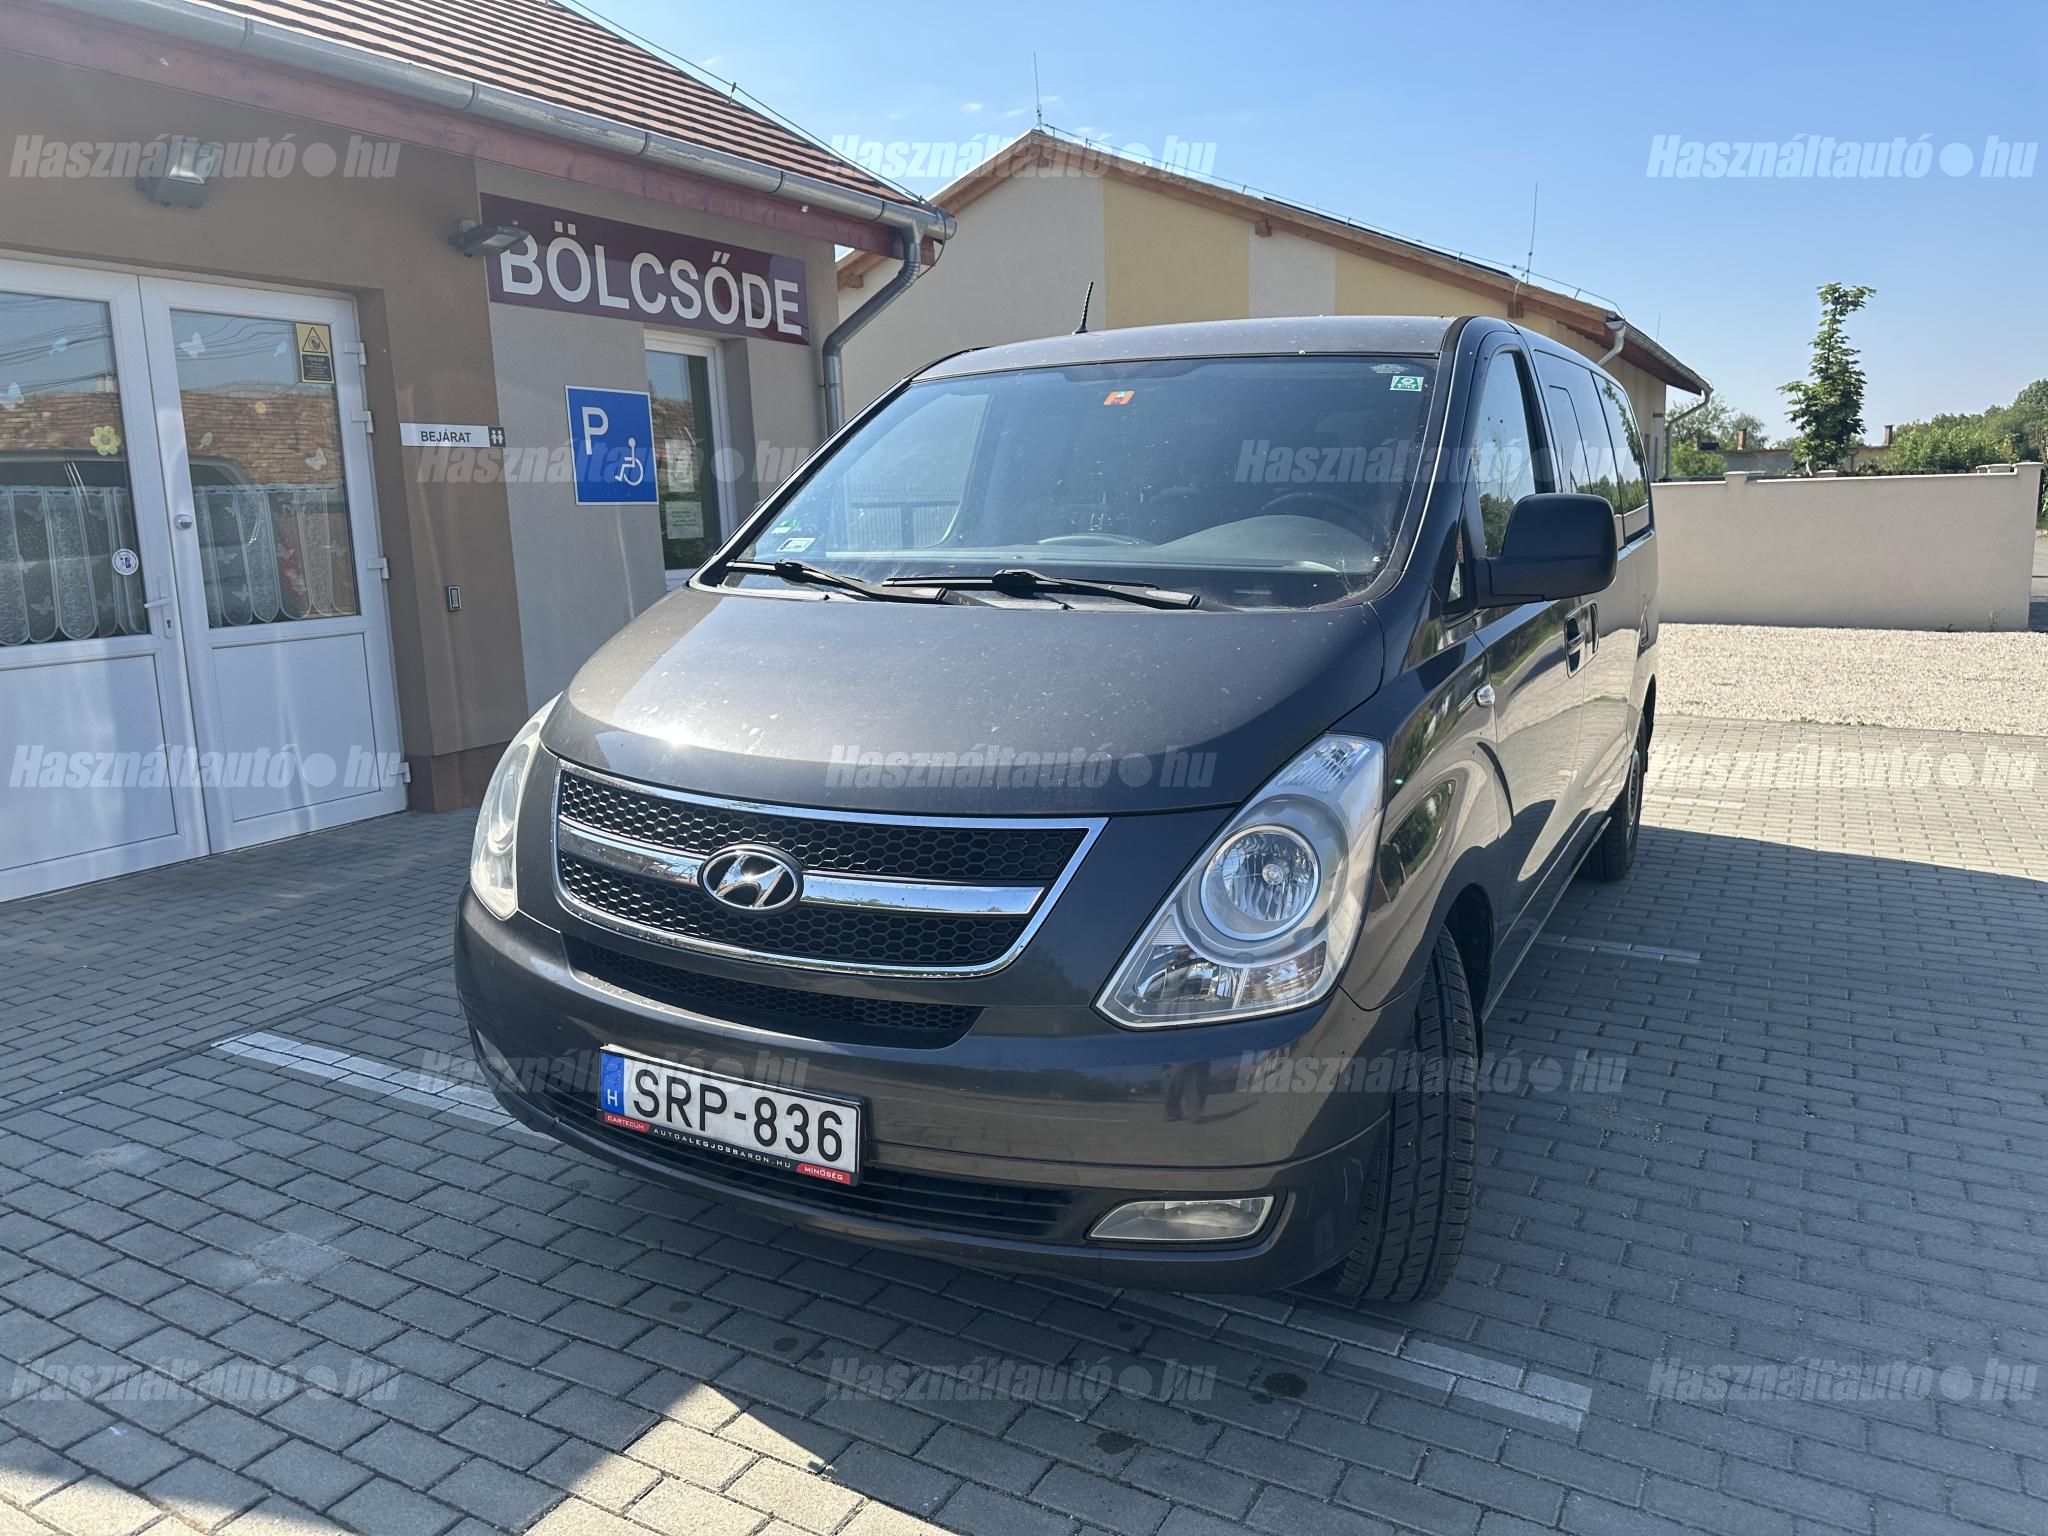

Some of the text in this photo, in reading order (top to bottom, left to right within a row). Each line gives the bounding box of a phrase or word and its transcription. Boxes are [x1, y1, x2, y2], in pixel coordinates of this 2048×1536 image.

[500, 219, 803, 336] BÖLCSŐDE
[420, 429, 472, 443] BEJÁRAT
[581, 406, 609, 455] P
[607, 1088, 618, 1107] H
[633, 1069, 843, 1163] SRP-836
